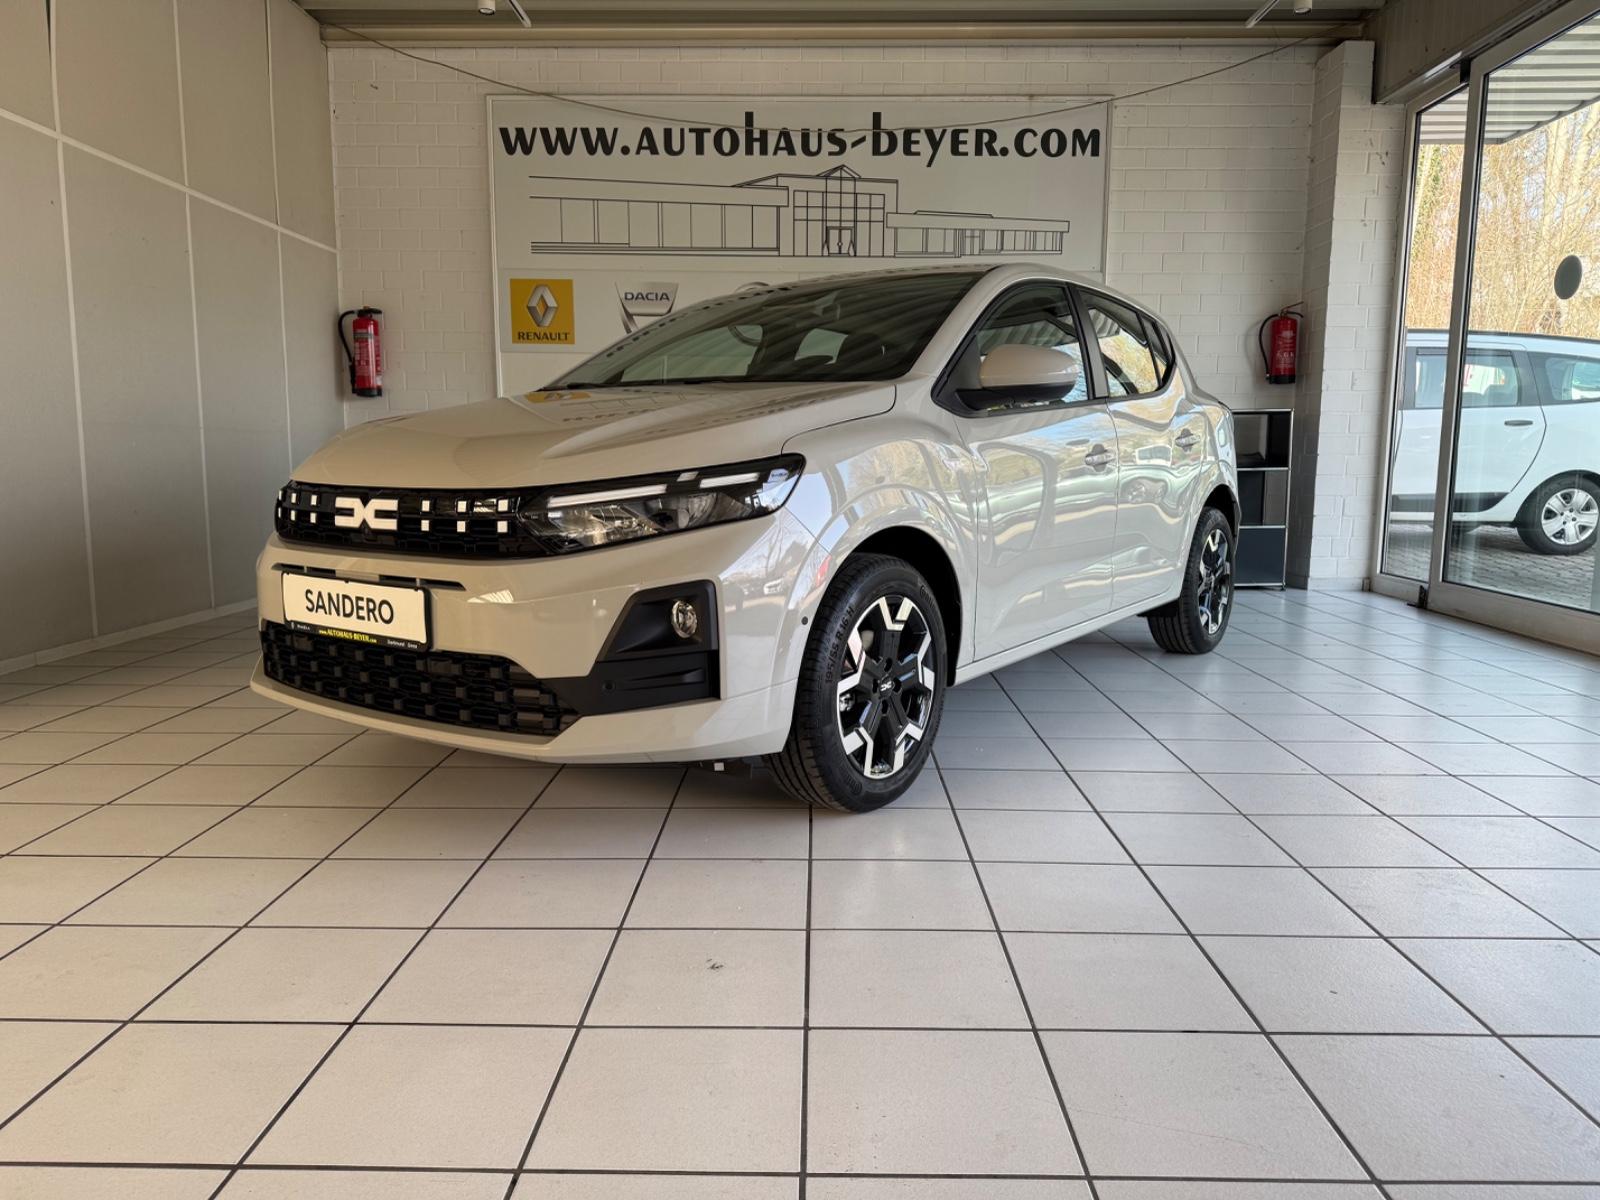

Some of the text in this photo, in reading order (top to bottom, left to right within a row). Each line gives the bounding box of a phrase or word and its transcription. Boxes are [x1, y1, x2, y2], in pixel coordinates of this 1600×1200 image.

[624, 291, 670, 301] DACIA
[517, 331, 571, 341] RENAULT
[305, 588, 394, 625] SANDERO
